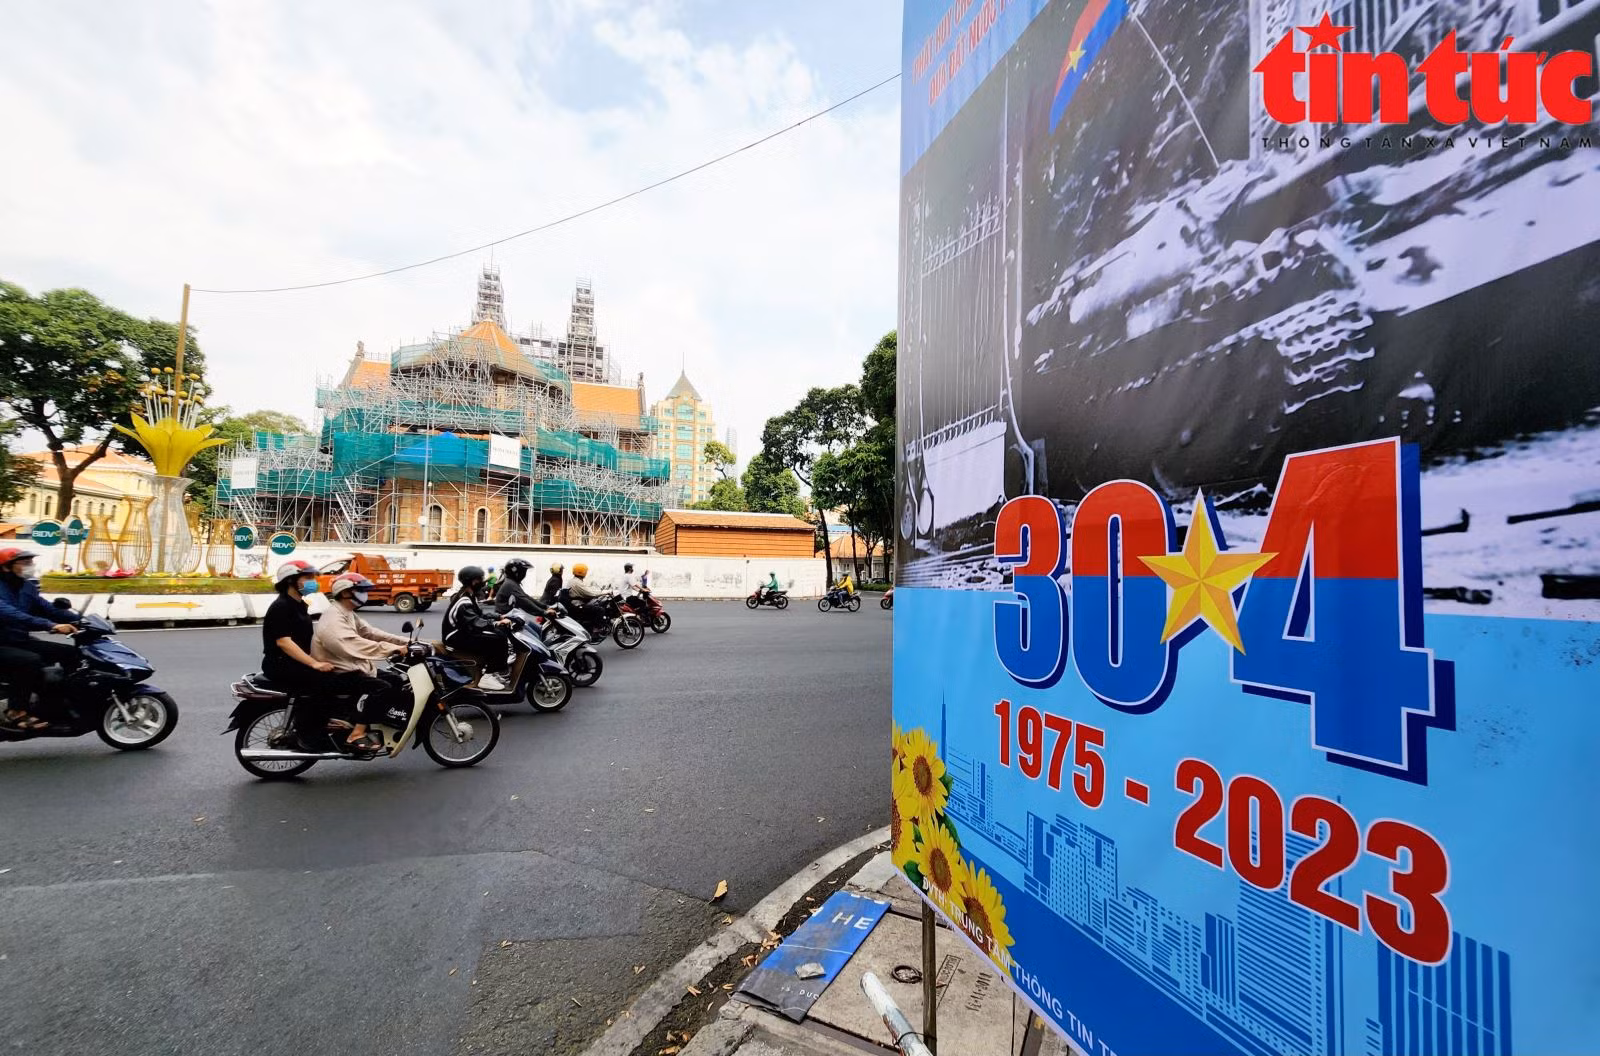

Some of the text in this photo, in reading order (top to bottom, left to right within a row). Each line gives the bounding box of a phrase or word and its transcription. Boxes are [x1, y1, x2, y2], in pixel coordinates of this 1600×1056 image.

[993, 699, 1105, 809] 1975
[1174, 758, 1453, 967] 2023
[950, 901, 984, 944] TRUNG
[1014, 961, 1063, 1020] THÔNG
[1067, 1009, 1093, 1050] TIN
